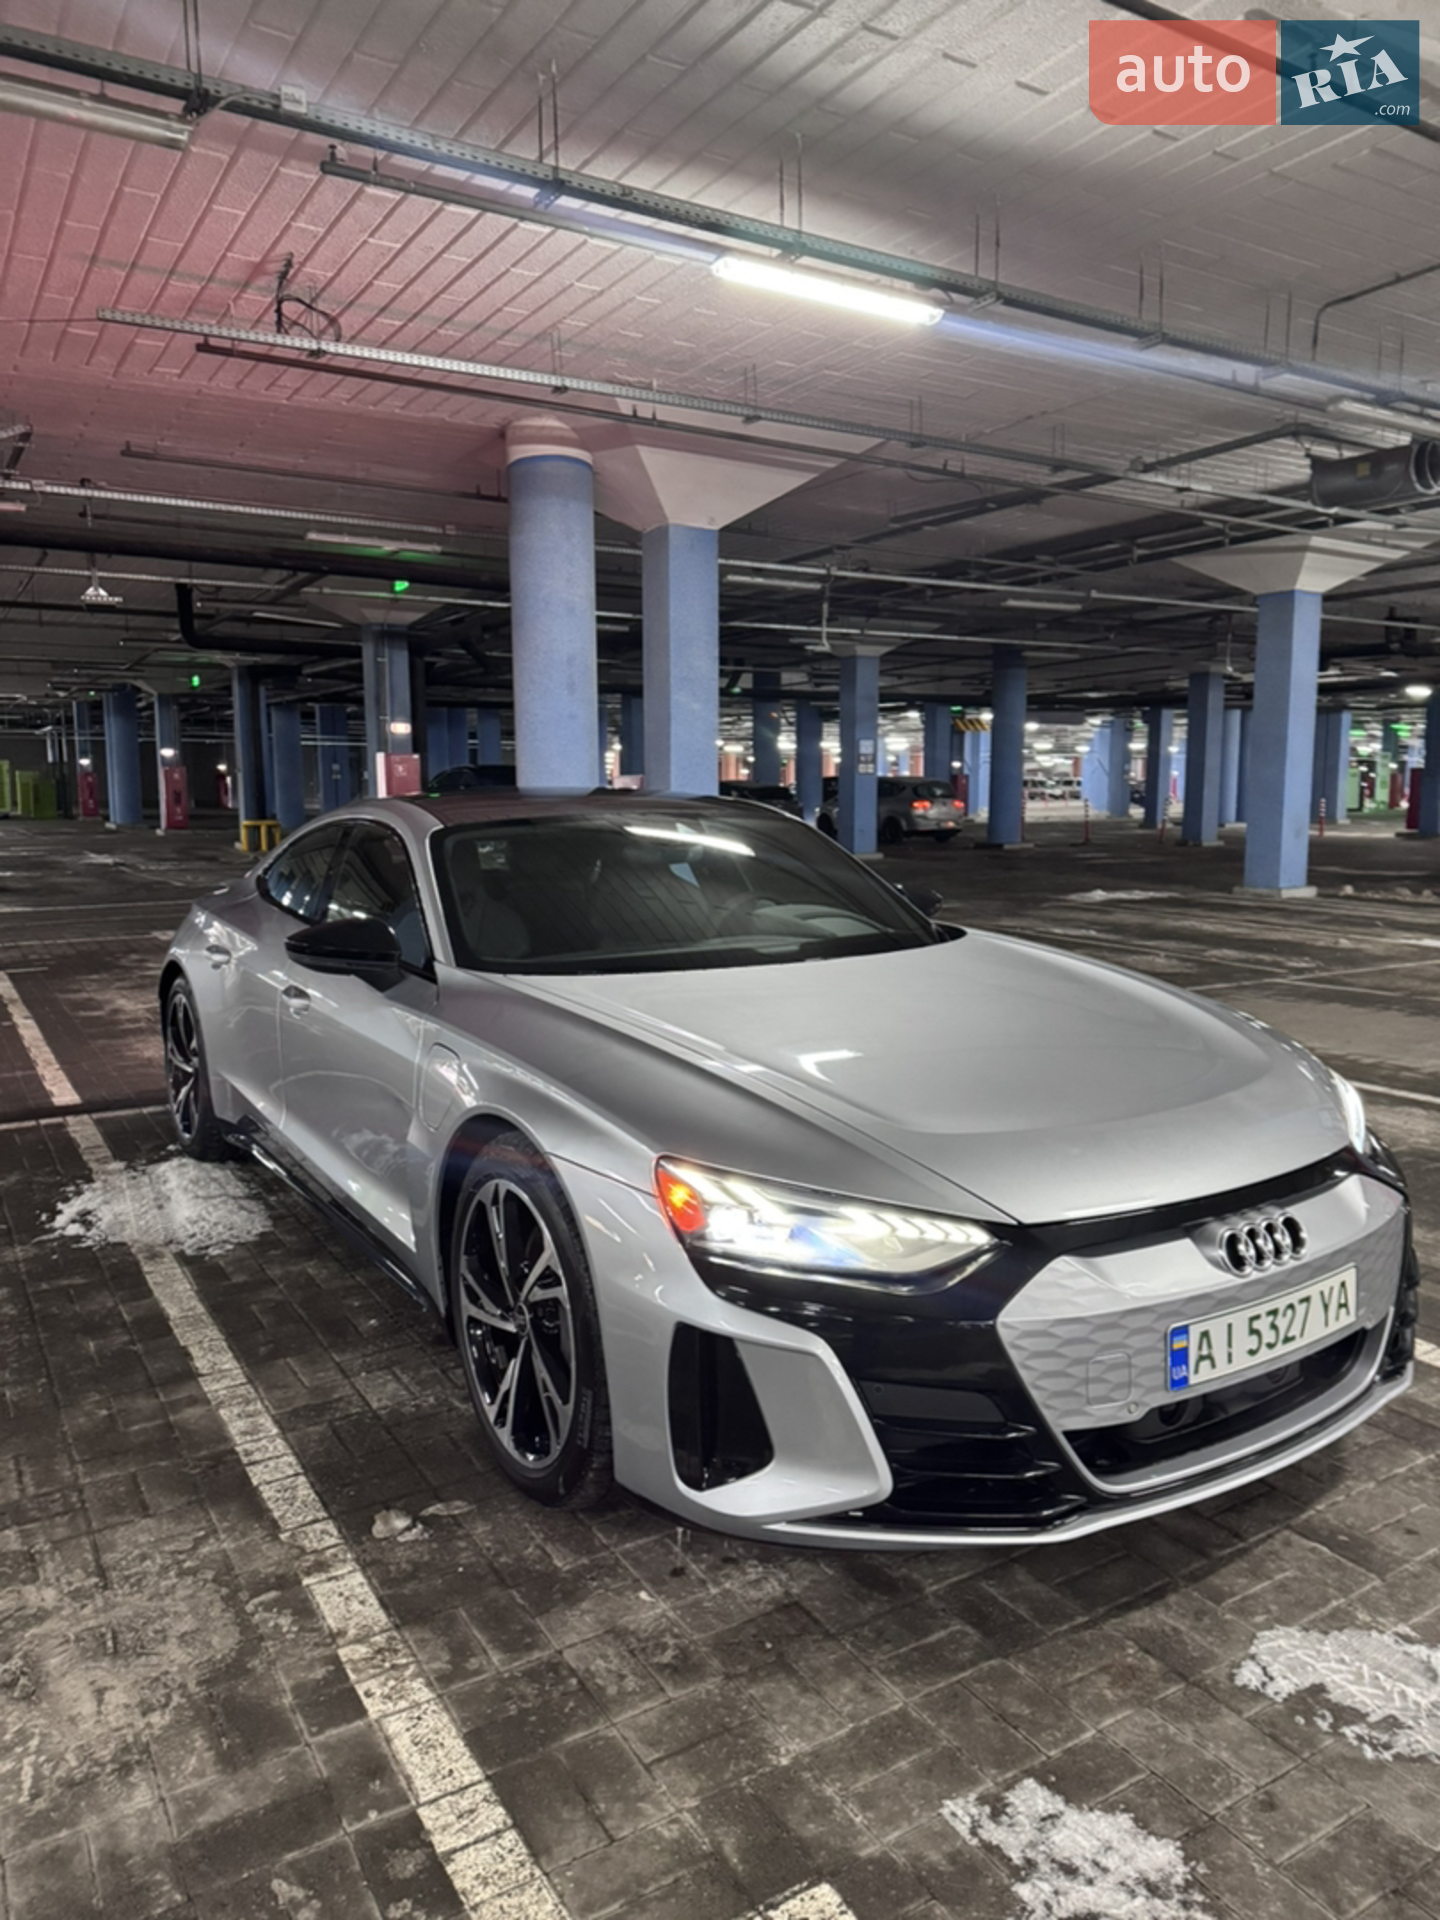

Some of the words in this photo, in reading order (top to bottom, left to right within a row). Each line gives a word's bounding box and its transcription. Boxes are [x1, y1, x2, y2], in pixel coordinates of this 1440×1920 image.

[1193, 1322, 1233, 1376] AI
[1246, 1295, 1312, 1357] 5327
[1319, 1280, 1351, 1328] YA
[1171, 1365, 1188, 1380] UA
